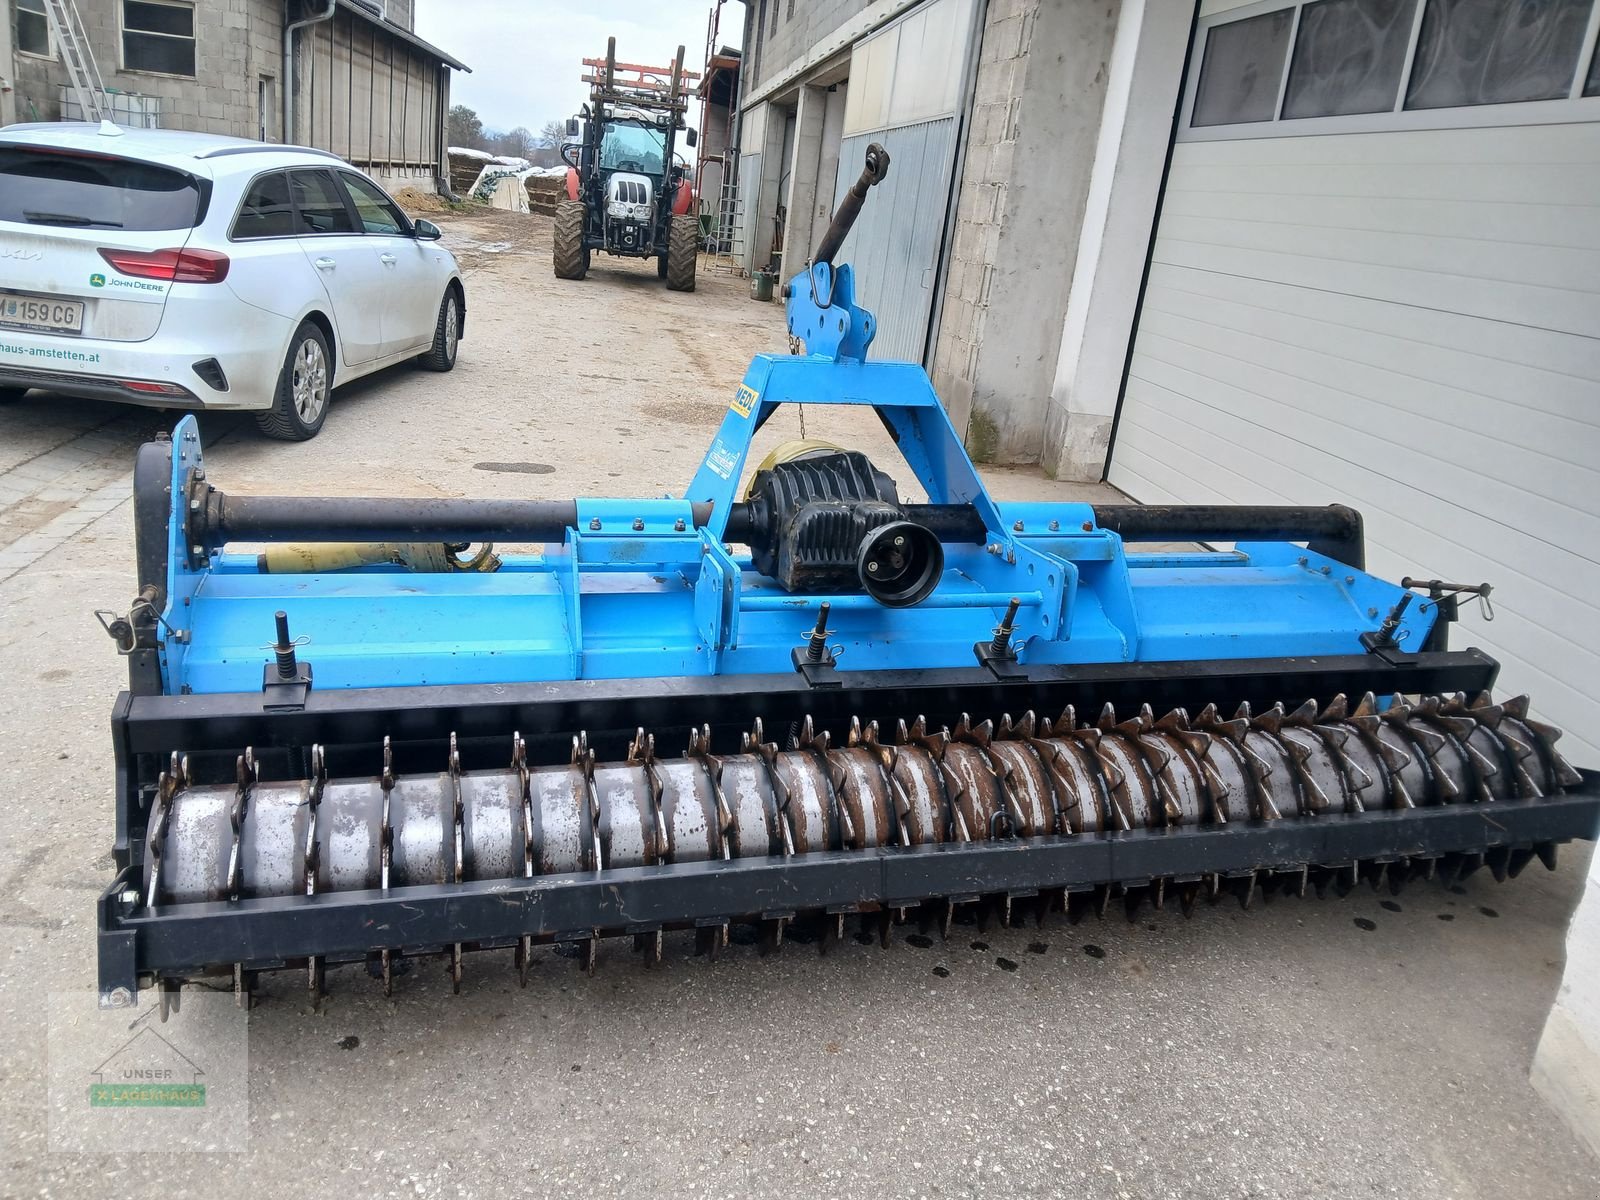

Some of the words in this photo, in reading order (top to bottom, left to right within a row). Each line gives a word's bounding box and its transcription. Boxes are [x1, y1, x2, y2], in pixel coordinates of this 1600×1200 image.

[108, 278, 133, 288] JOHN
[134, 281, 164, 292] DEERE
[20, 301, 49, 321] 159
[53, 305, 74, 324] CG
